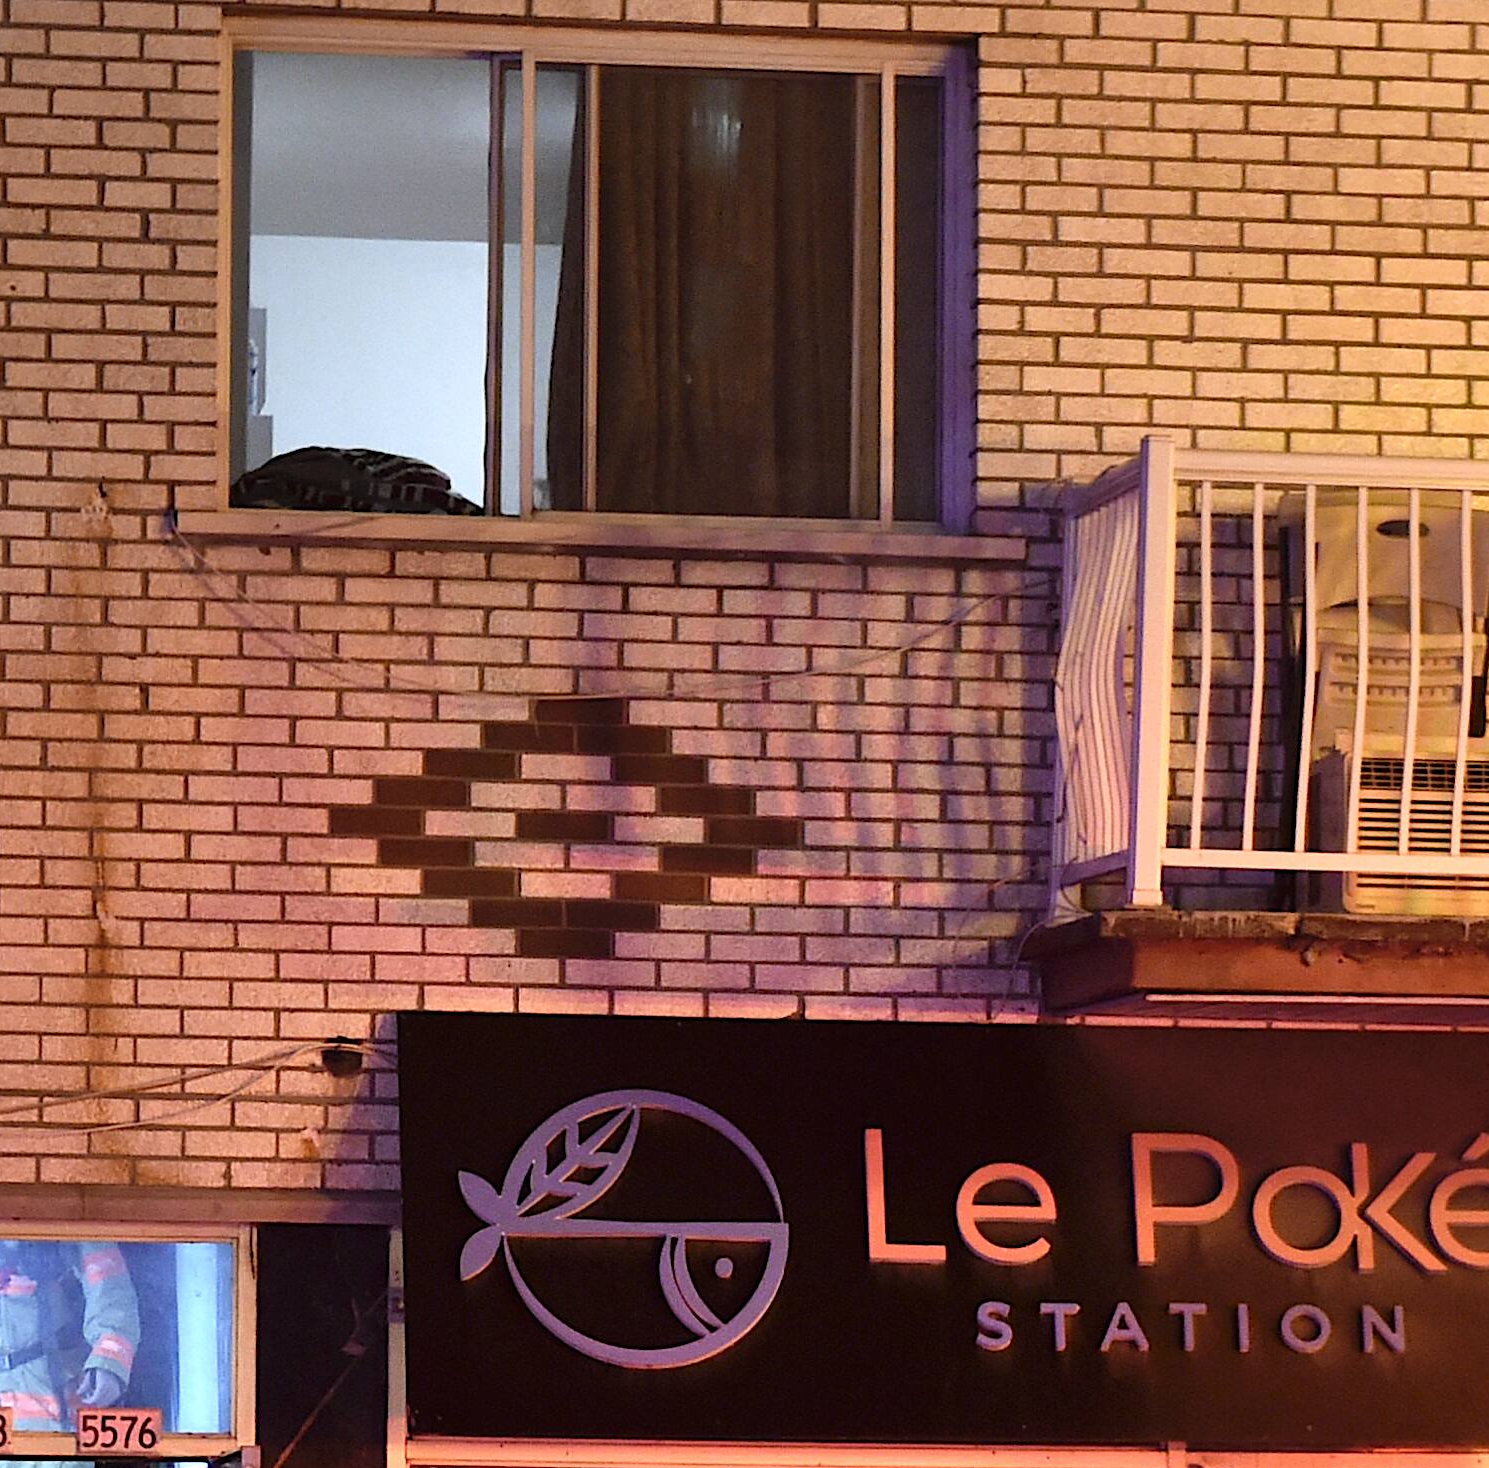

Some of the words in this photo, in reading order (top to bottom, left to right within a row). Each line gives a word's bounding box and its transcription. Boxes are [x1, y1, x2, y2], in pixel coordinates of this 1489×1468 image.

[865, 1128, 1057, 1265] Le
[976, 1301, 1406, 1354] STATION
[82, 1415, 157, 1449] 5576
